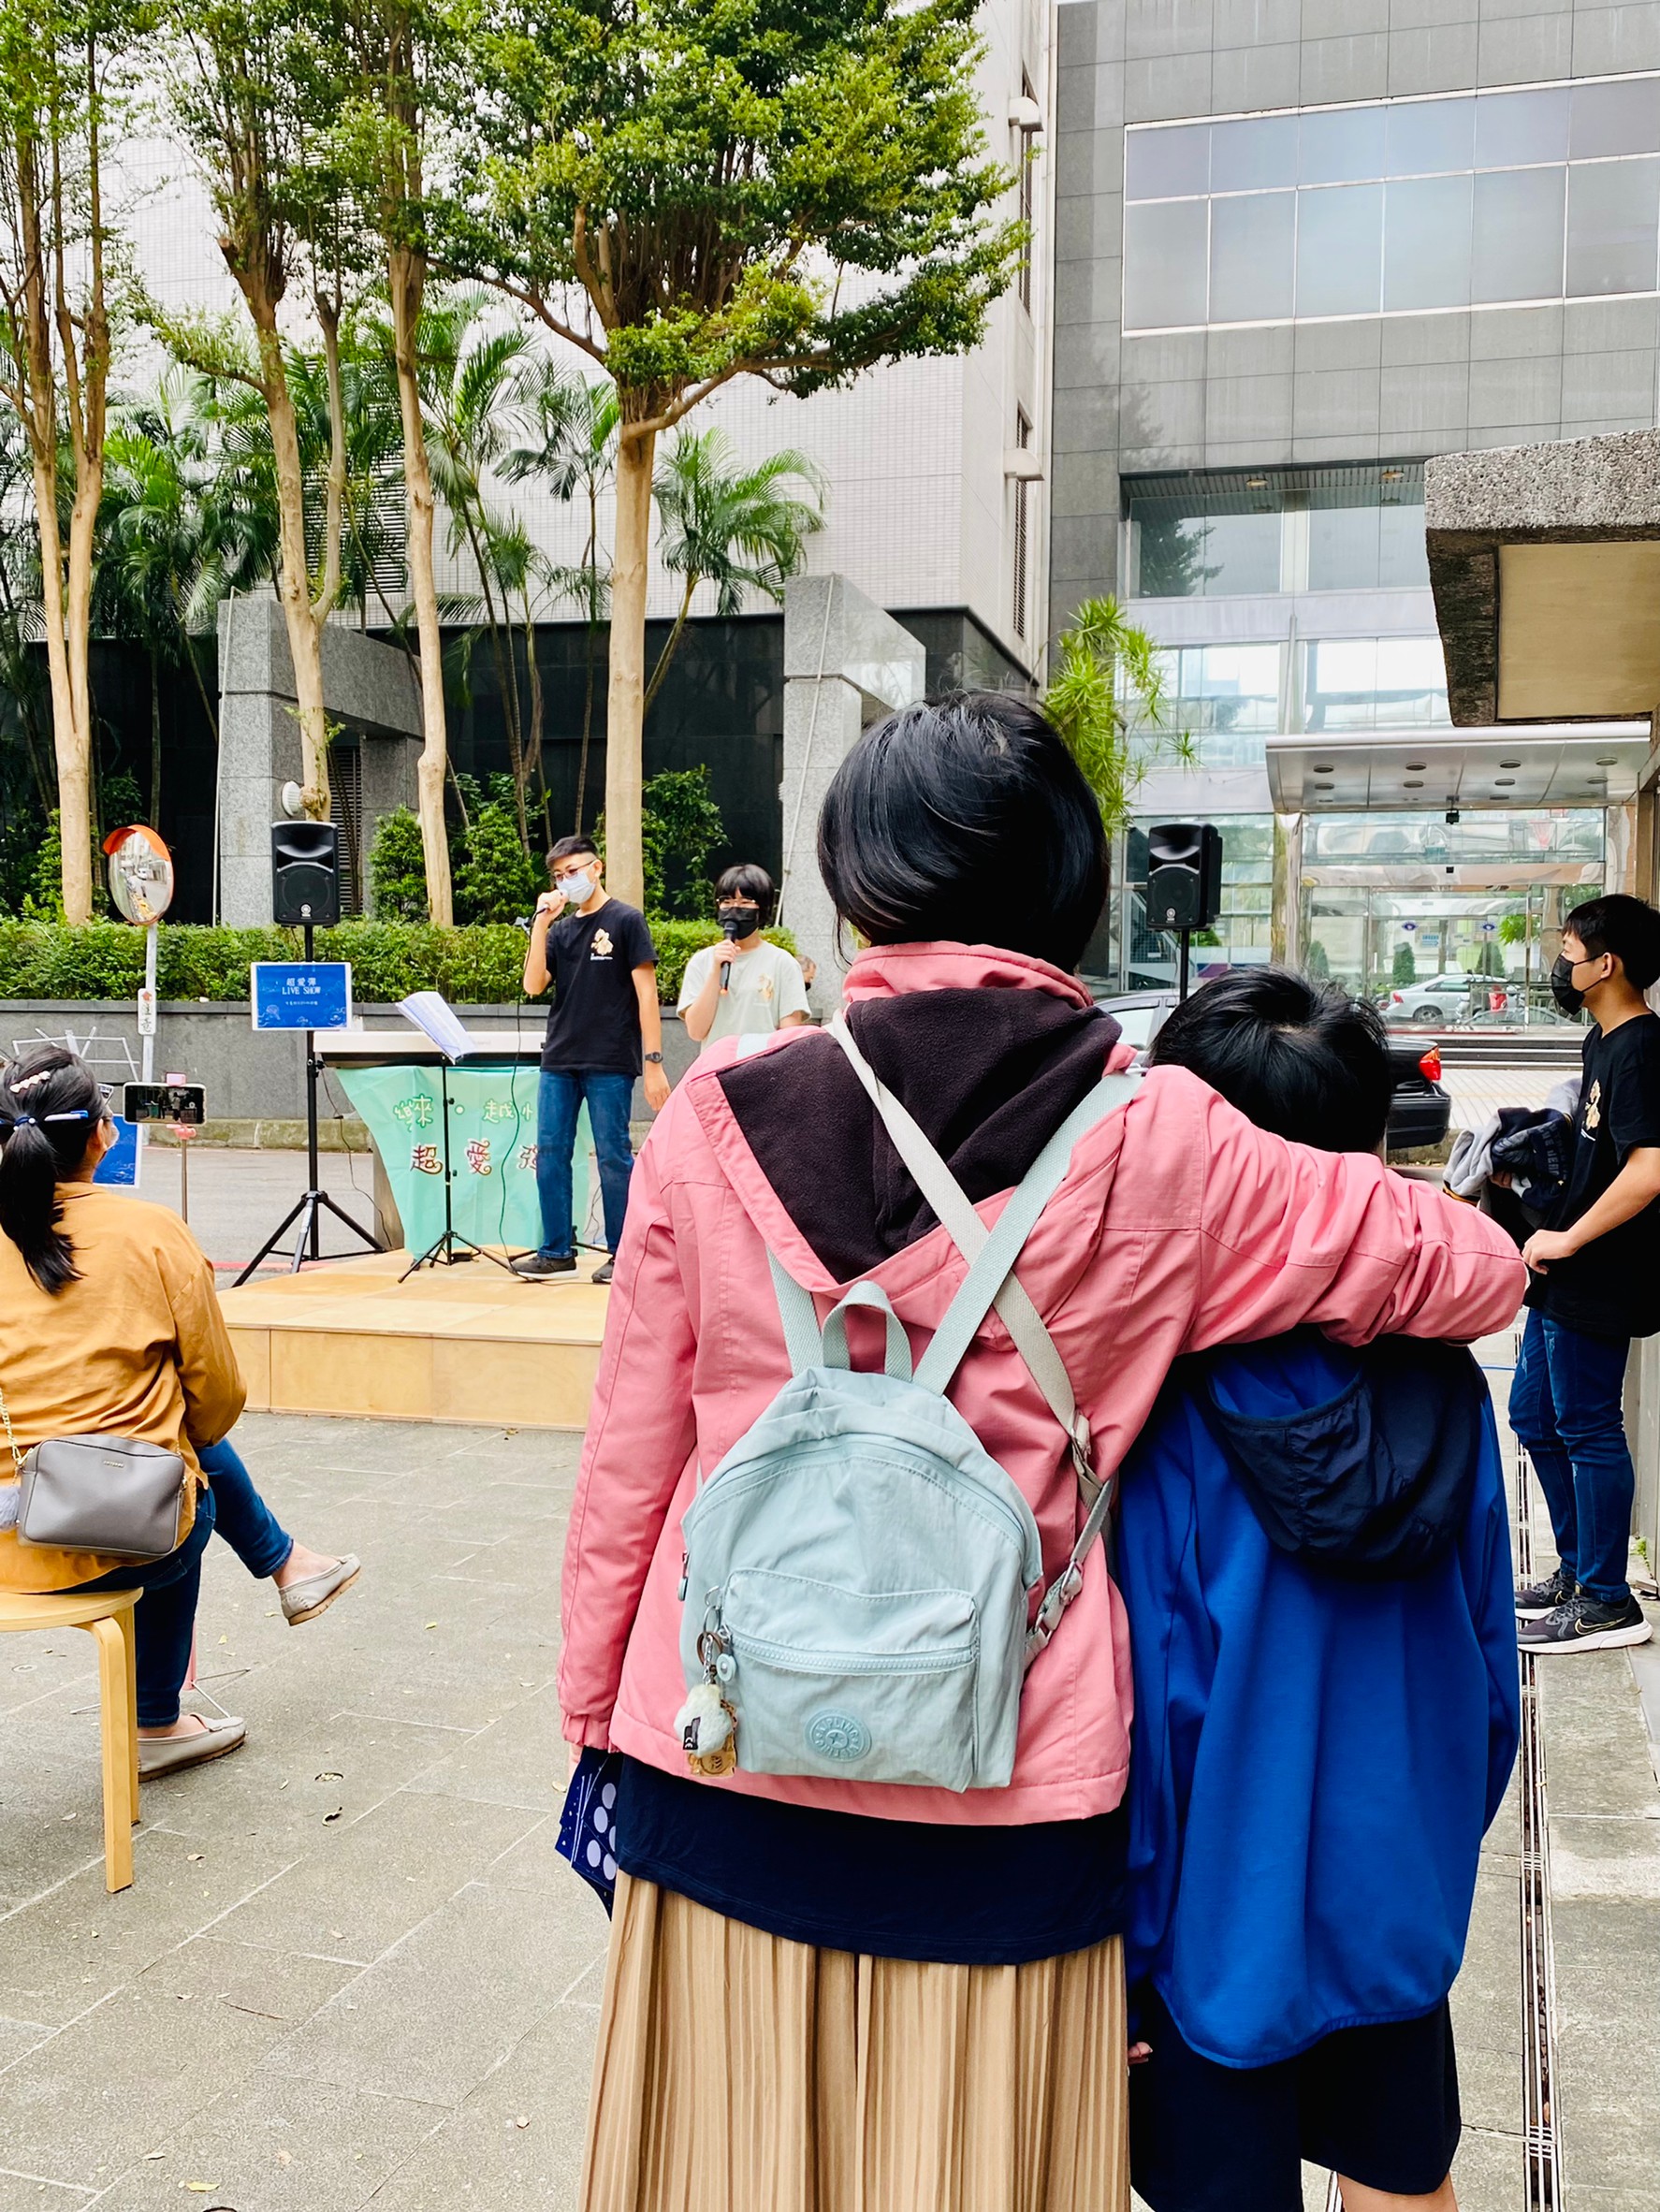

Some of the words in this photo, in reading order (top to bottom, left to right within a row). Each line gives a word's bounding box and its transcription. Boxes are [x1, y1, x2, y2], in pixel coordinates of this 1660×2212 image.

[286, 977, 316, 986] 超愛彈
[282, 986, 300, 995] LIVE
[302, 986, 321, 995] SHOW
[815, 1717, 859, 1736] KIPLING
